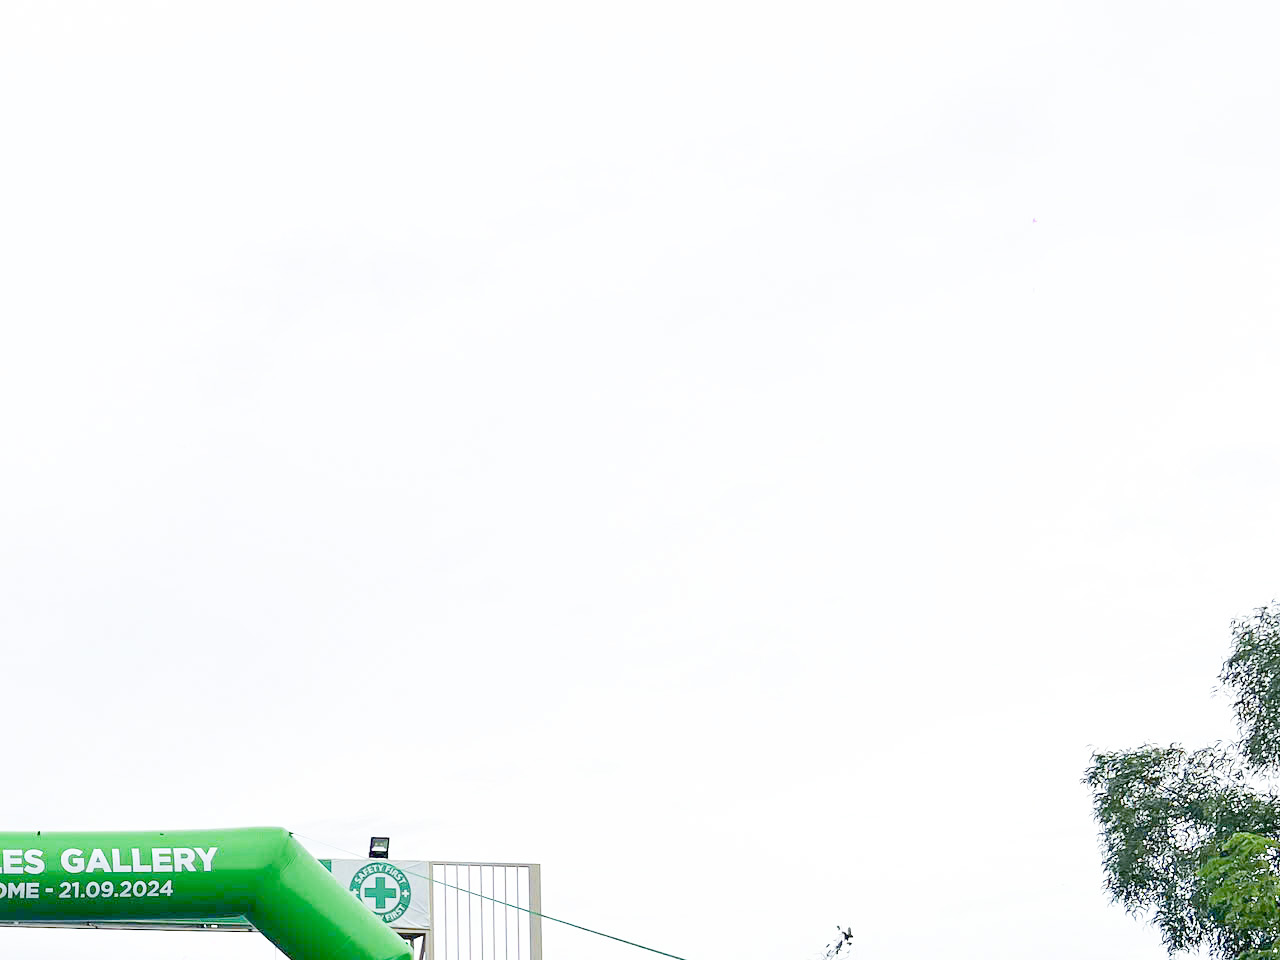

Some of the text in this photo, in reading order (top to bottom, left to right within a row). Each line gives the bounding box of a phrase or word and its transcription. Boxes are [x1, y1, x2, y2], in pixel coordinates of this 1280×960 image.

[60, 847, 217, 873] GALLERY
[354, 864, 406, 884] SAFETY FIRST
[59, 880, 173, 898] 21.09.2024
[386, 904, 406, 921] FIRST
